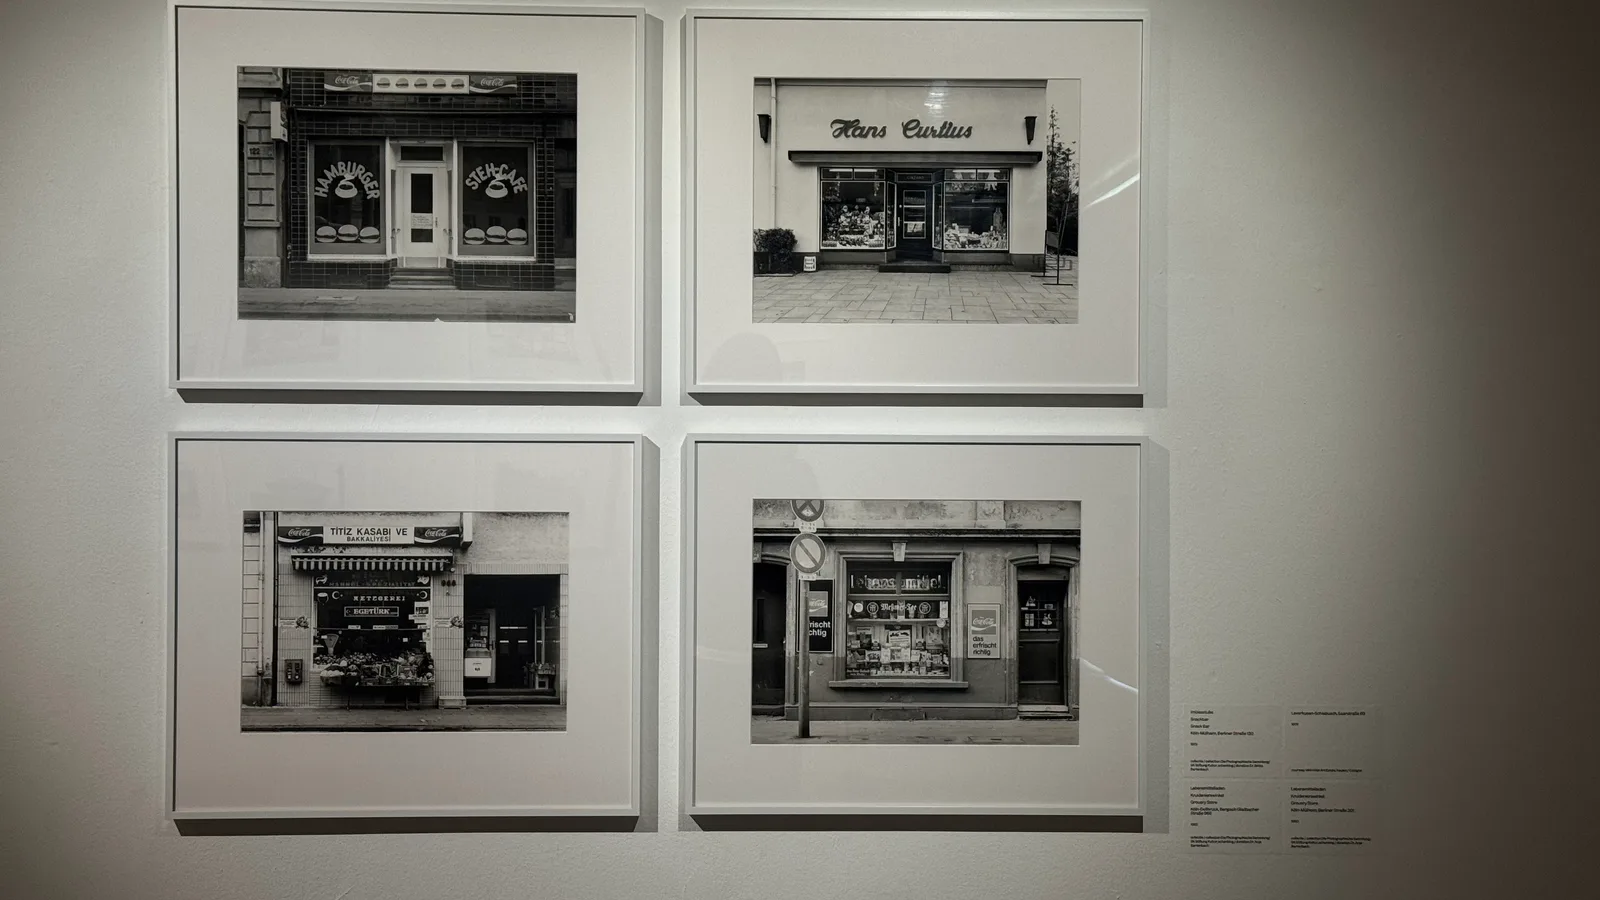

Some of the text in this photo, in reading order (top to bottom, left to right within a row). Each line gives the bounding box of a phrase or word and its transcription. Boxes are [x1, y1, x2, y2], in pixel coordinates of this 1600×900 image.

[830, 119, 973, 139] Hans Curtius
[314, 161, 381, 200] HAMBURGER
[287, 528, 311, 537] Coca-Cola
[356, 527, 391, 536] KASABI
[395, 527, 408, 536] VE
[424, 528, 448, 537] Coca-Cola
[809, 629, 827, 638] chtig
